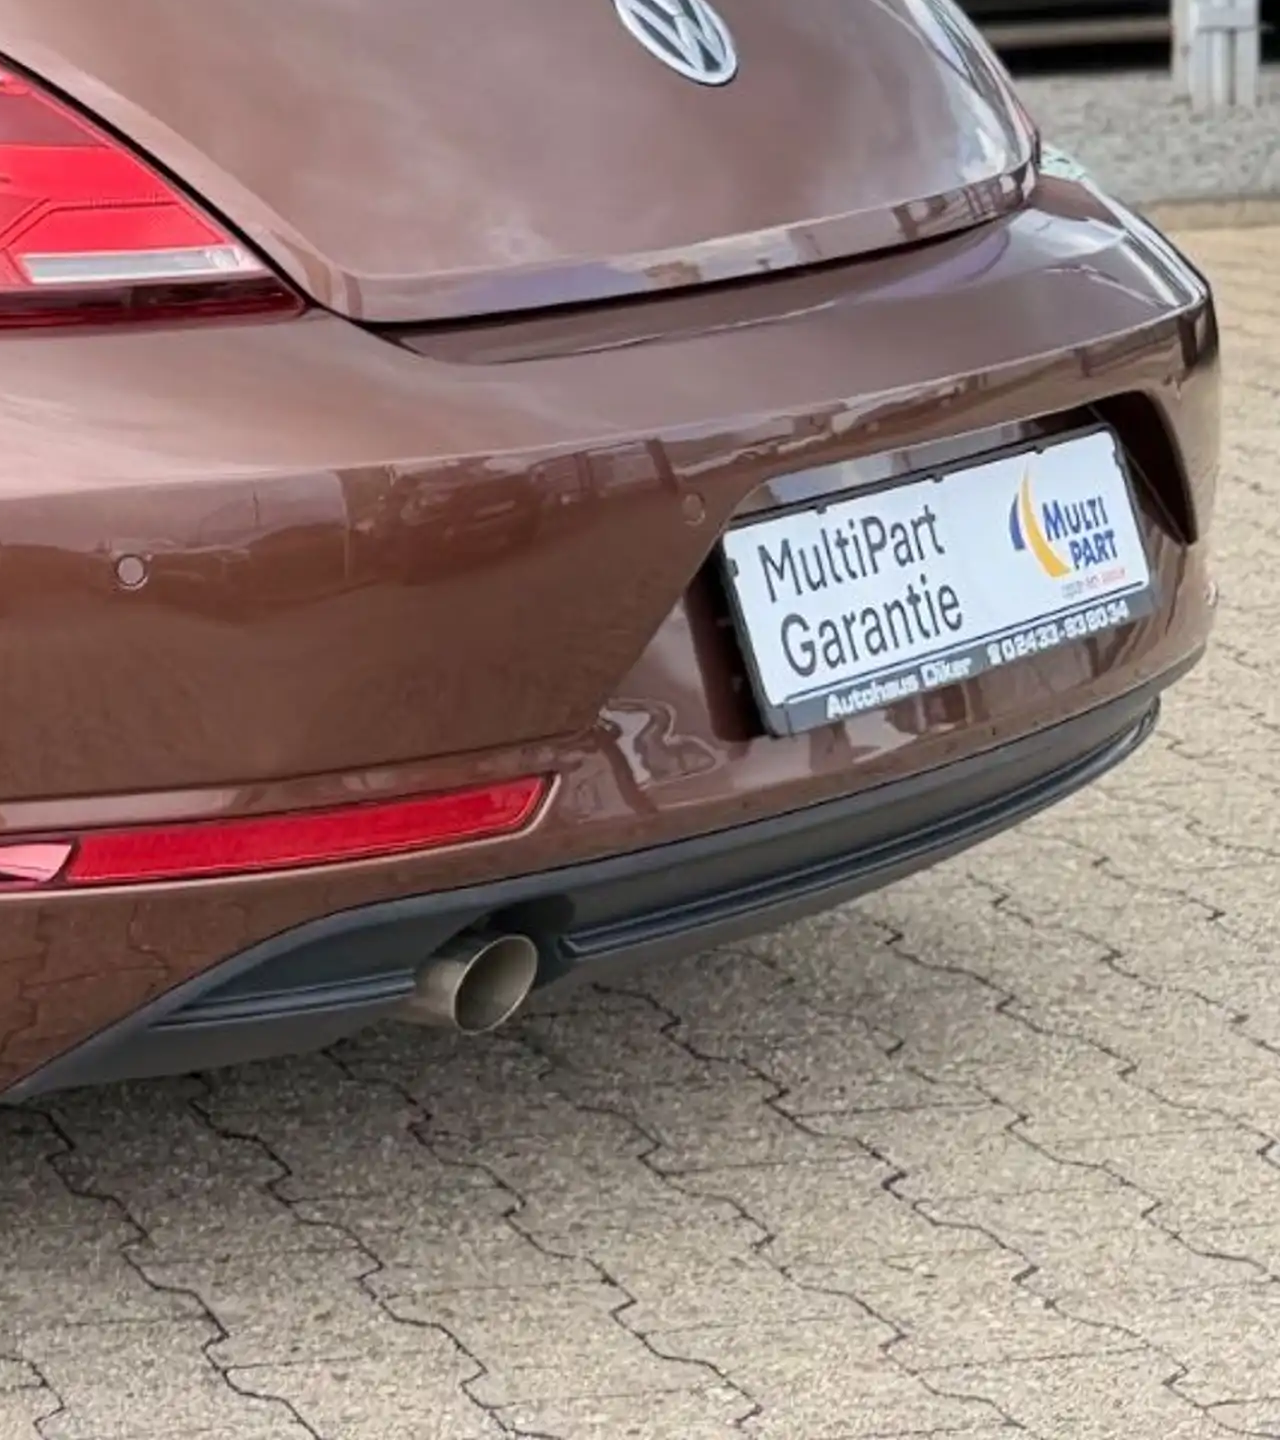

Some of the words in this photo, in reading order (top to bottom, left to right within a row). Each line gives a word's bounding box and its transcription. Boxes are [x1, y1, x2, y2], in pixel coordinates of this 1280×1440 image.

[757, 504, 945, 603] MultiPart
[1042, 495, 1108, 542] MULTI
[1069, 529, 1118, 571] PART
[781, 573, 962, 677] Garantie
